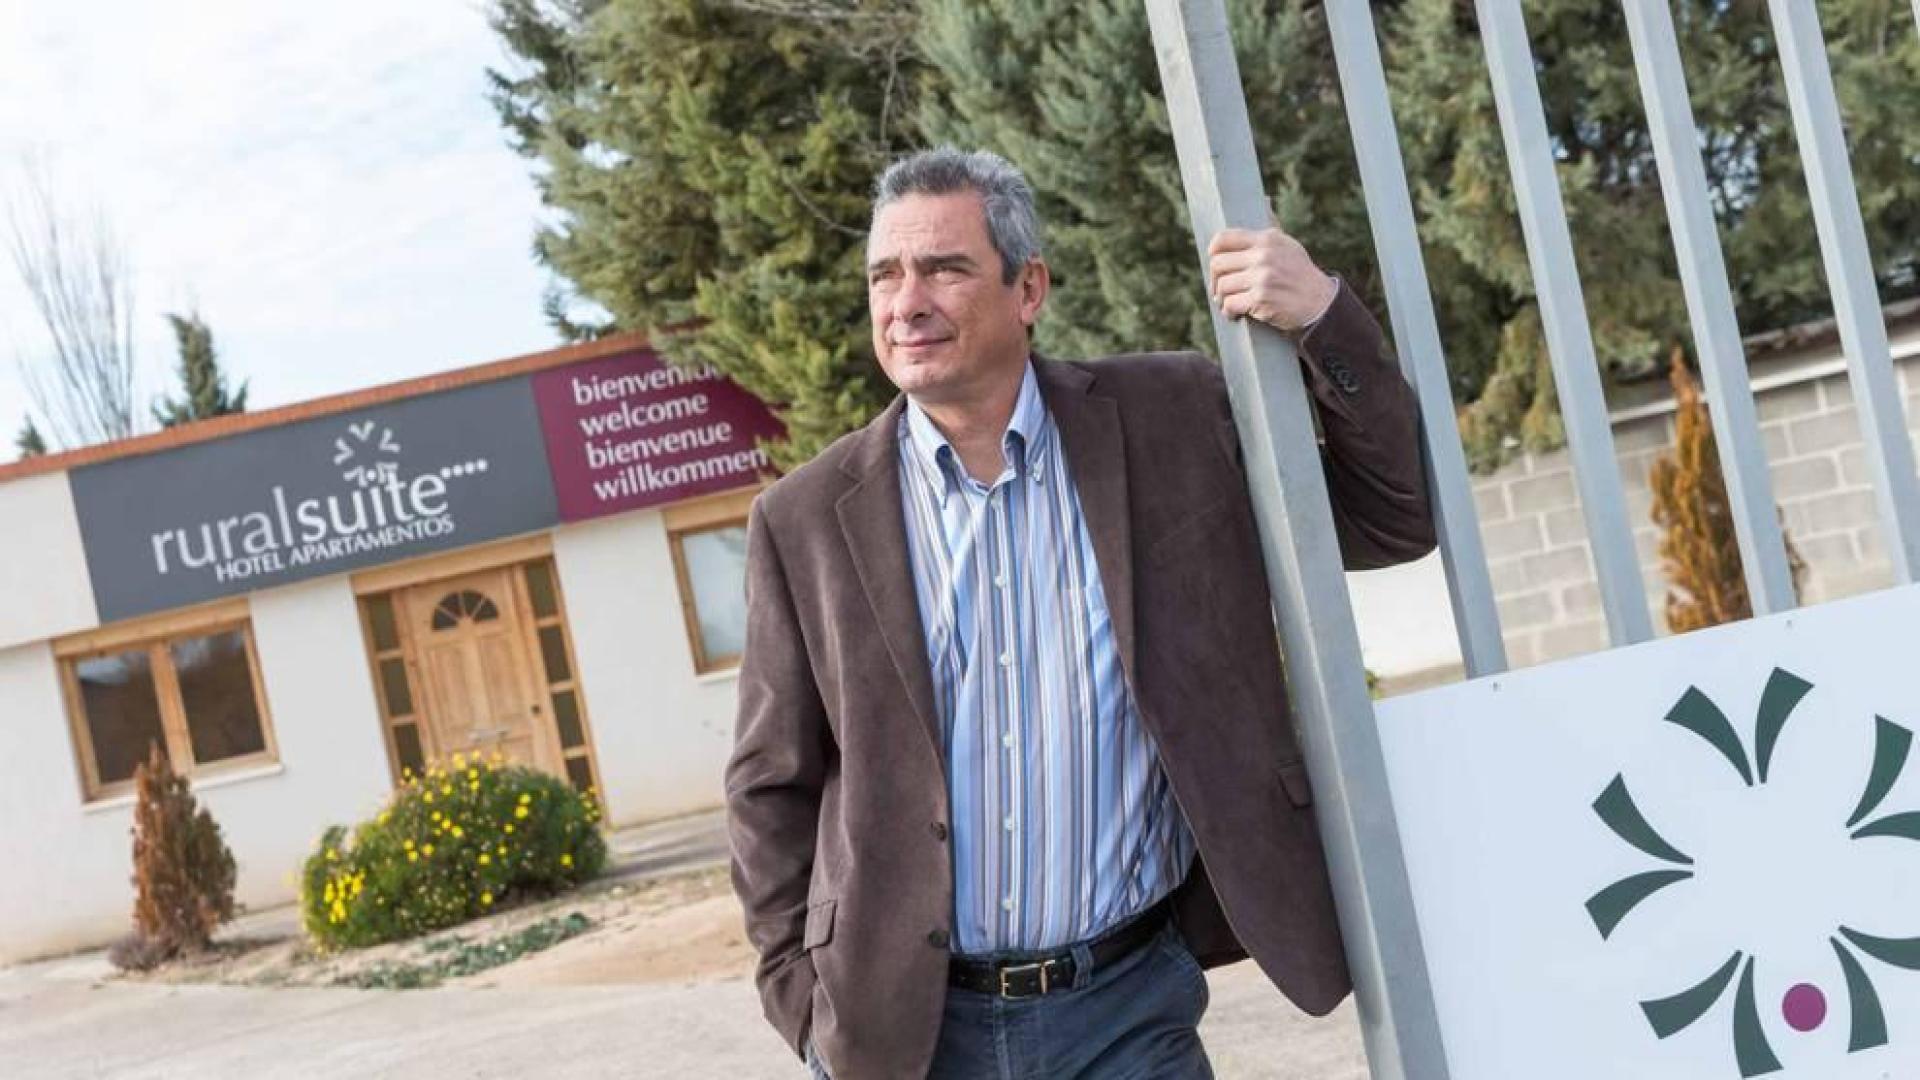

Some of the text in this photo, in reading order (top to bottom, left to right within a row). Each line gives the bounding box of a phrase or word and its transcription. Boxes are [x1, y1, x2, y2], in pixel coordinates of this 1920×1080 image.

[579, 393, 709, 437] welcome
[585, 421, 733, 469] bienvenue
[593, 448, 767, 501] willkommen
[152, 468, 449, 574] ruralsuite
[214, 513, 455, 582] HOTEL APARTAMENTOS
